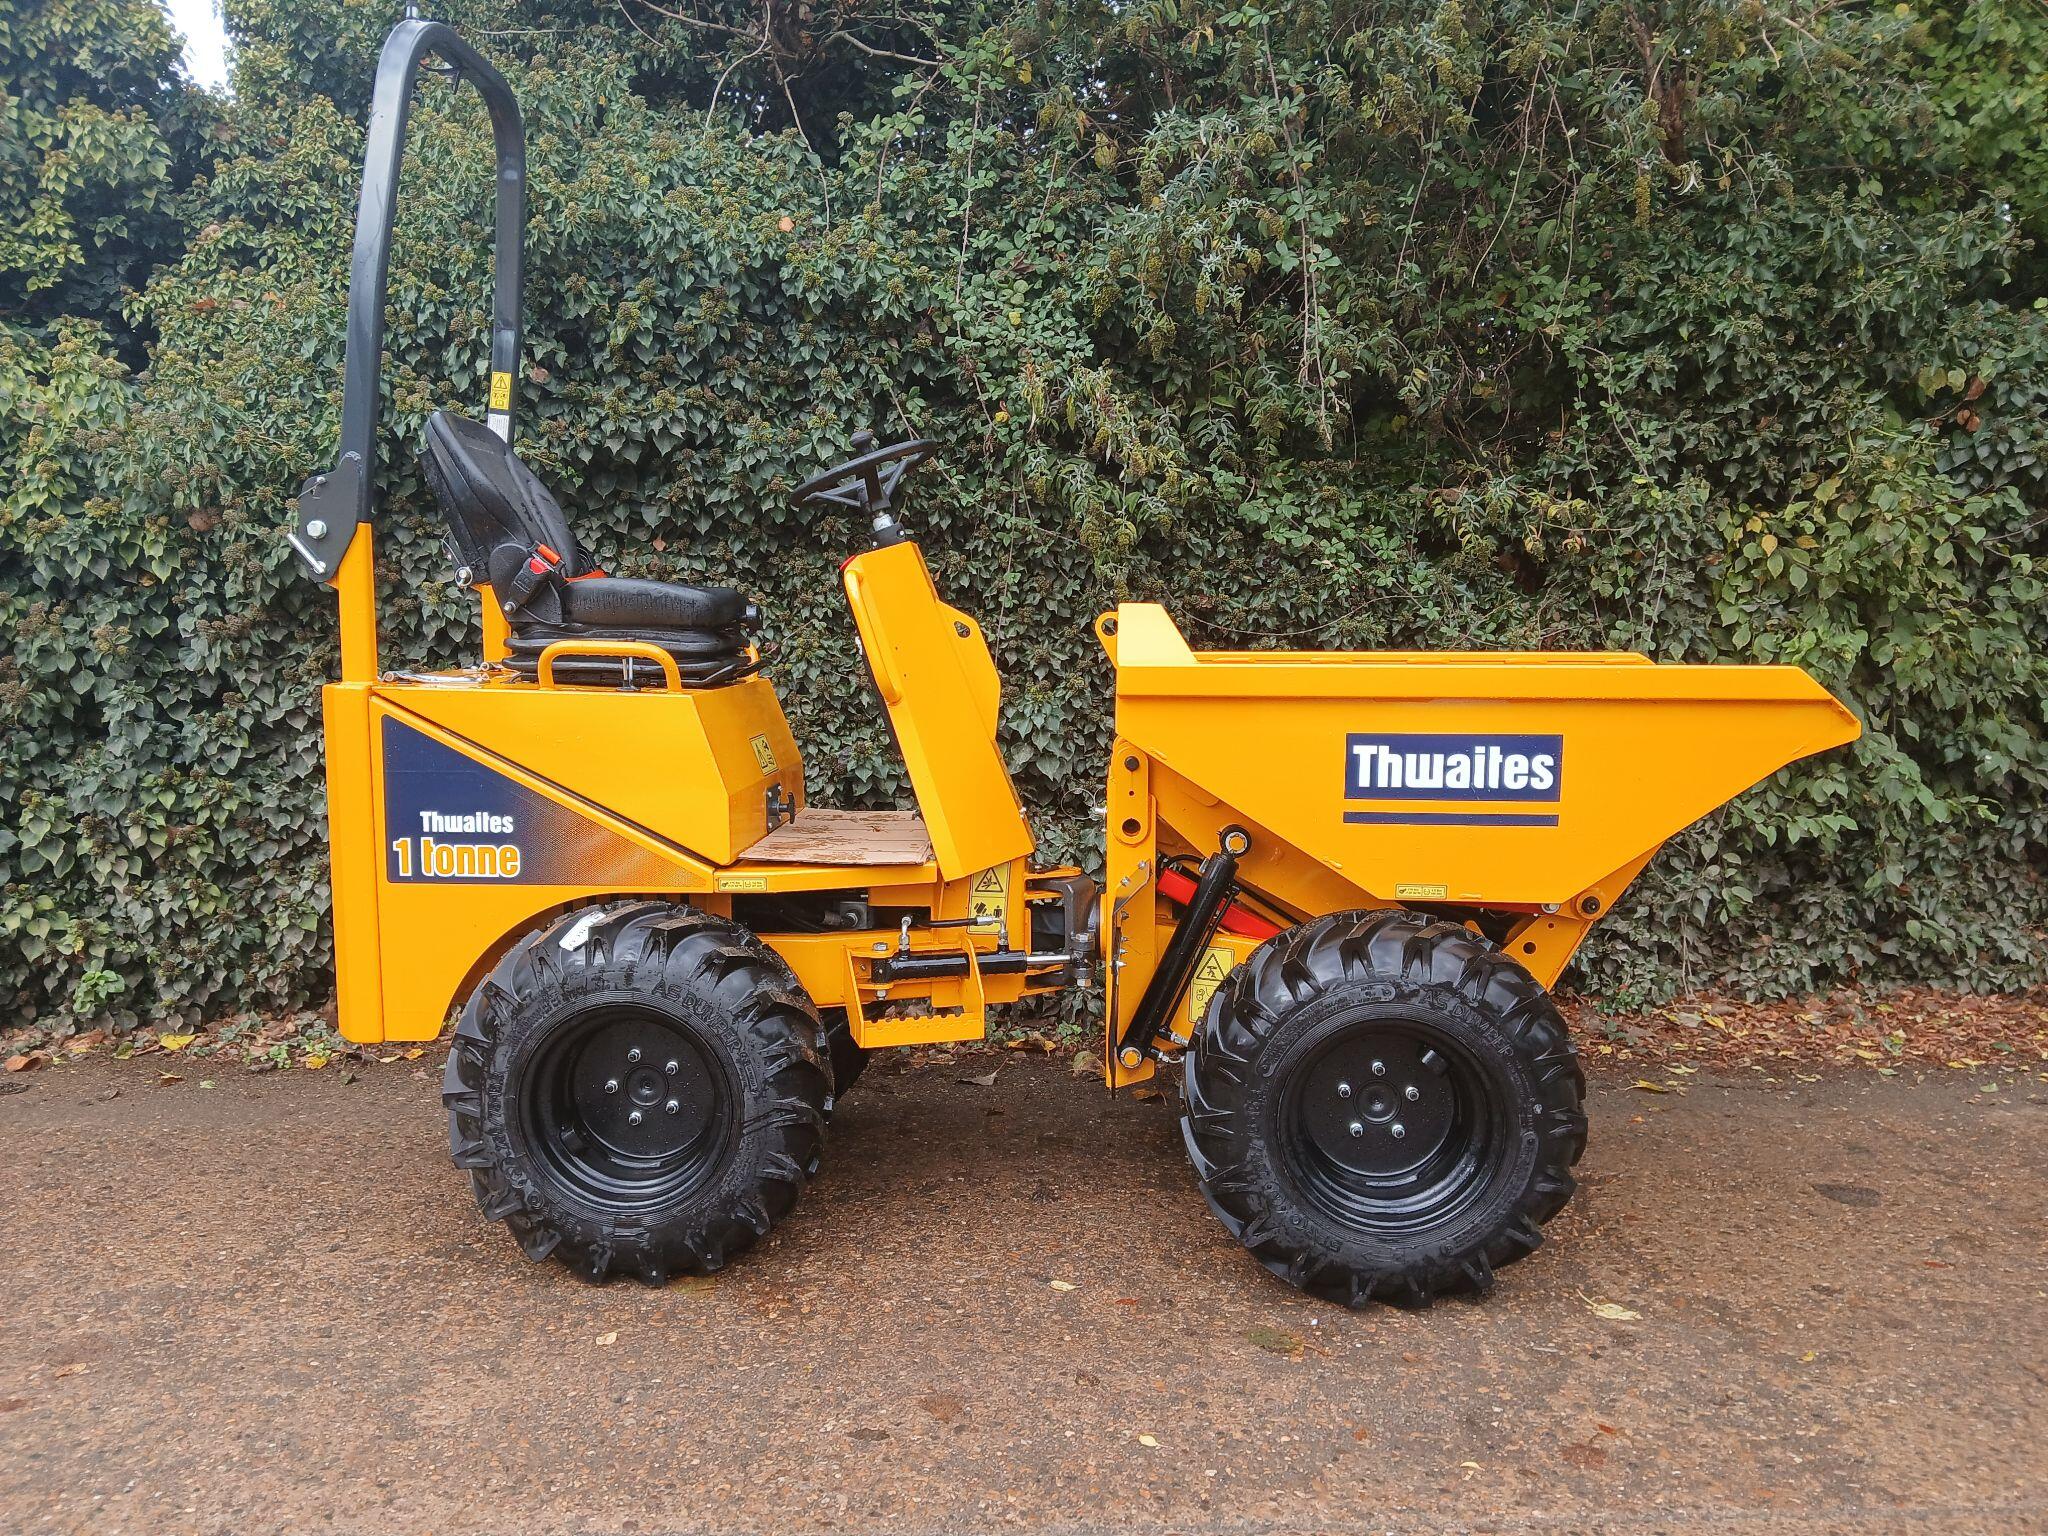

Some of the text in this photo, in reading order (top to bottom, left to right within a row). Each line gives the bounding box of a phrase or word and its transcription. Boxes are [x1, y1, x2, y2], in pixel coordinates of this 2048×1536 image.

[1353, 745, 1555, 790] Thwaites
[420, 811, 514, 833] Thwaites
[393, 837, 520, 878] 1 tonne
[651, 978, 742, 1054] AS DUMPER
[1424, 989, 1515, 1058] AS DUMPER
